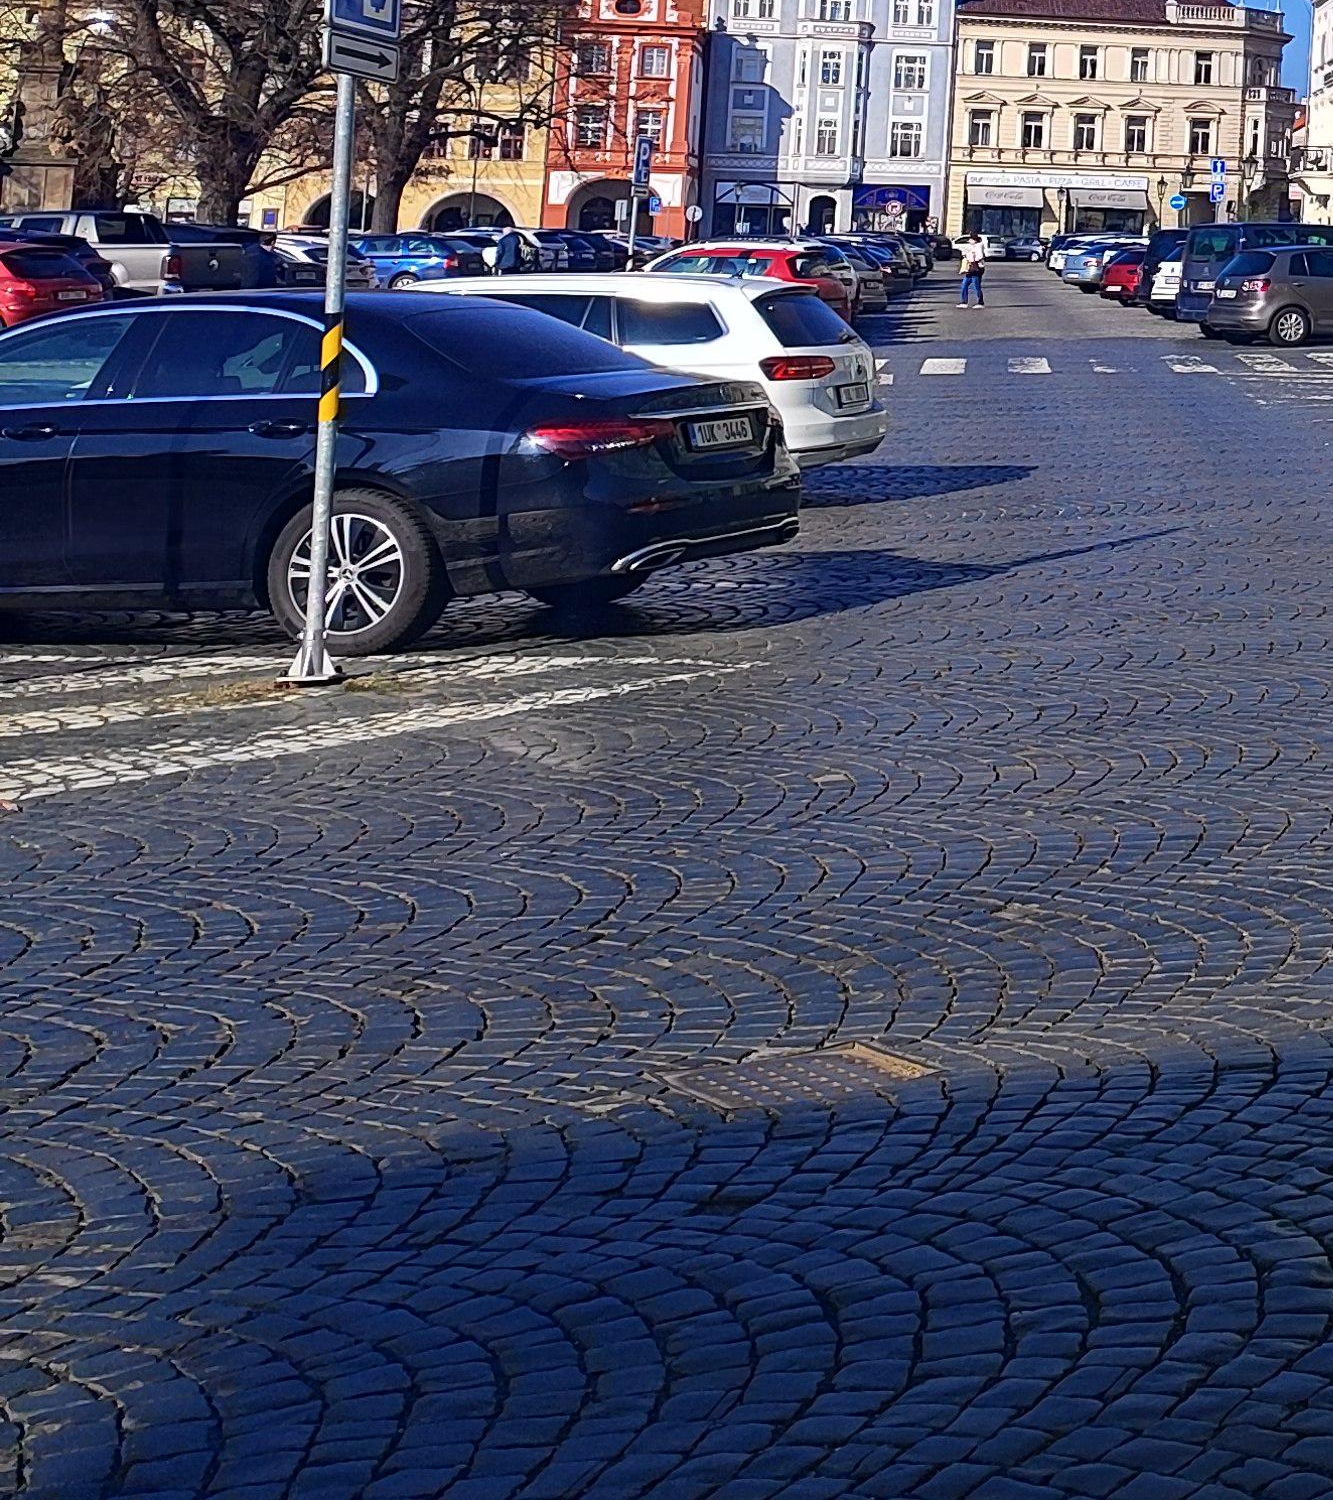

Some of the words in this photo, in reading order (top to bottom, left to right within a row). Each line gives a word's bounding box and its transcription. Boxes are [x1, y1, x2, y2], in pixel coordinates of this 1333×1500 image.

[639, 143, 649, 170] P
[1213, 184, 1223, 197] P
[698, 424, 718, 443] 1UK
[723, 420, 748, 440] 3446
